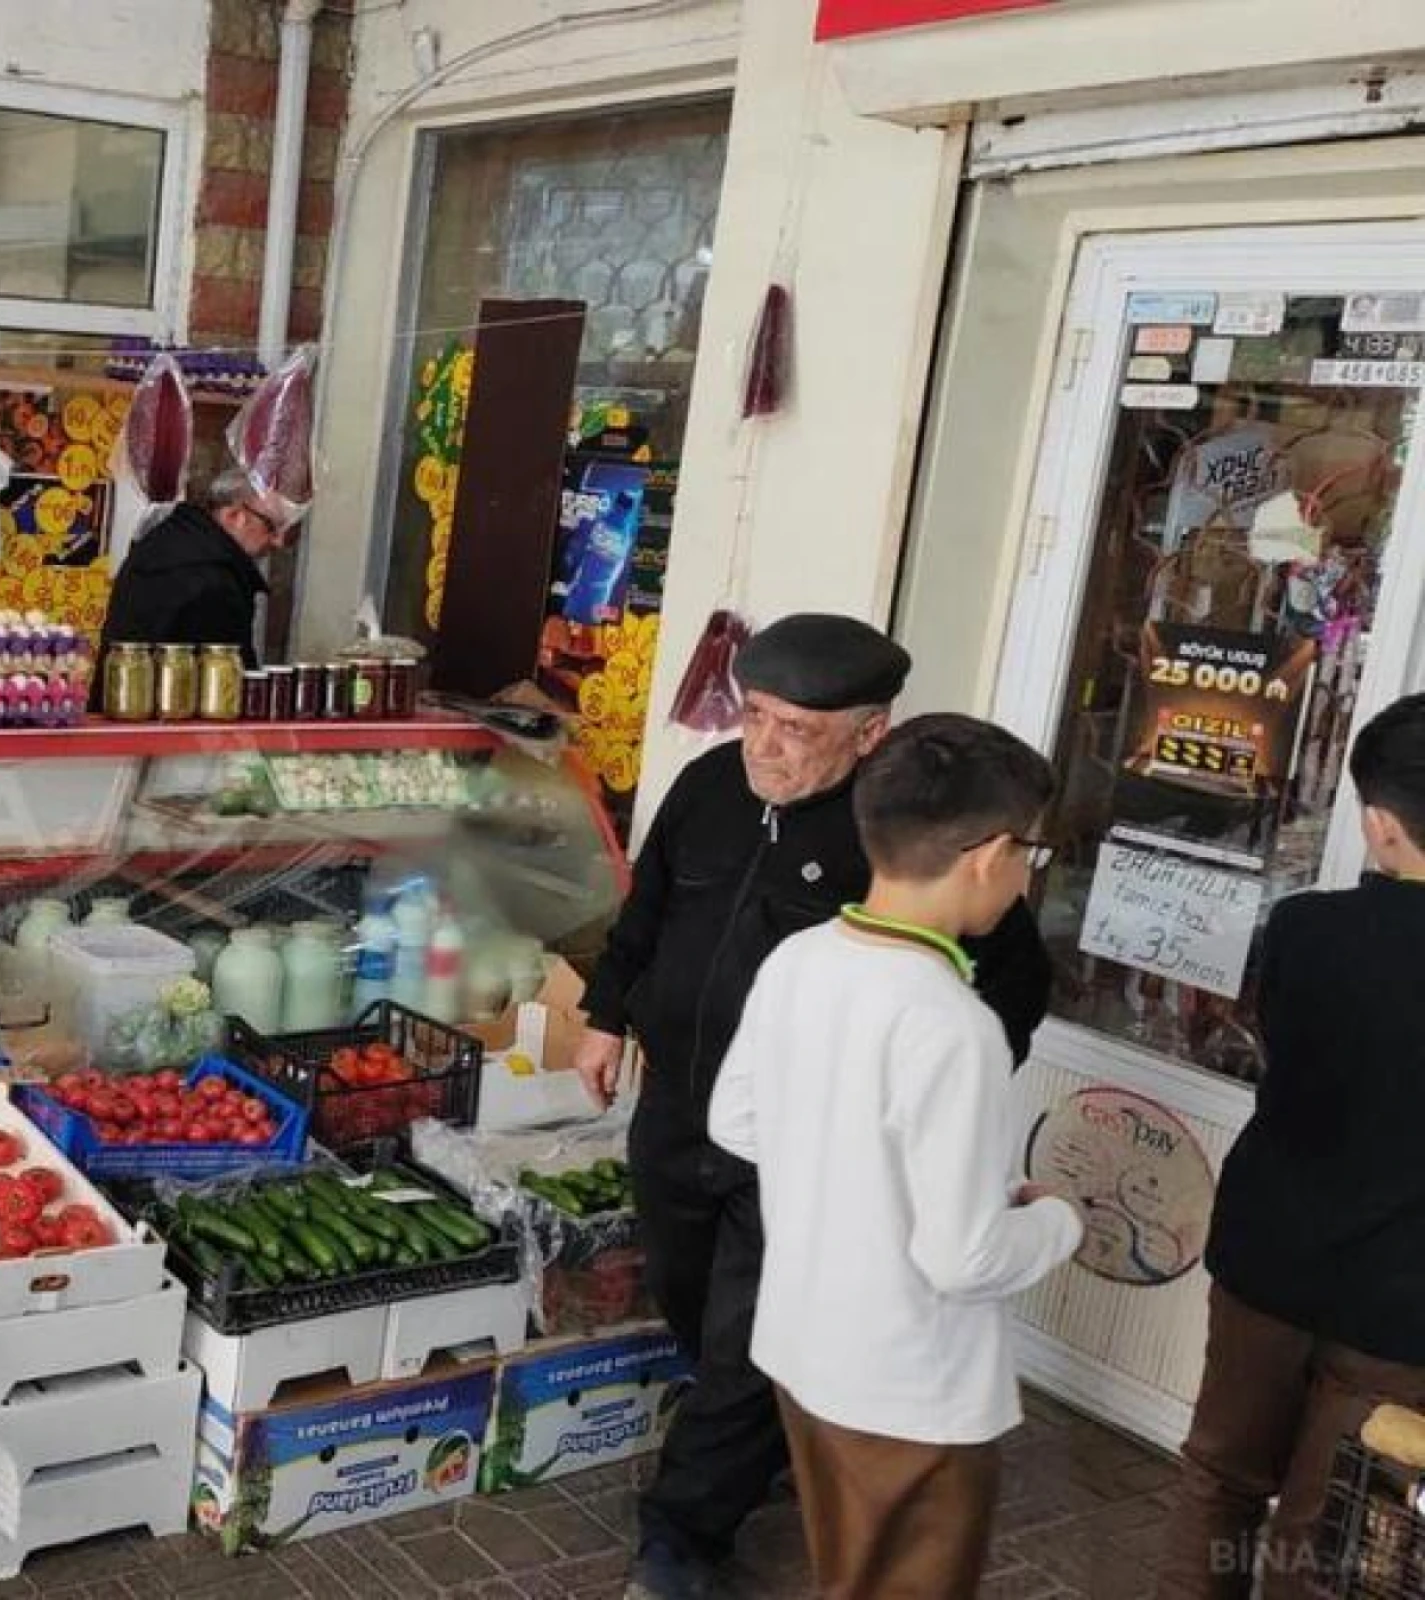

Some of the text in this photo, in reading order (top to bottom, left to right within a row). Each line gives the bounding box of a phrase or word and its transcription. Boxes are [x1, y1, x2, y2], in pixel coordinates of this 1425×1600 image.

[1149, 656, 1190, 685] 25
[1193, 662, 1262, 695] 000
[1132, 925, 1193, 970] 35
[296, 1412, 373, 1439] Bananas
